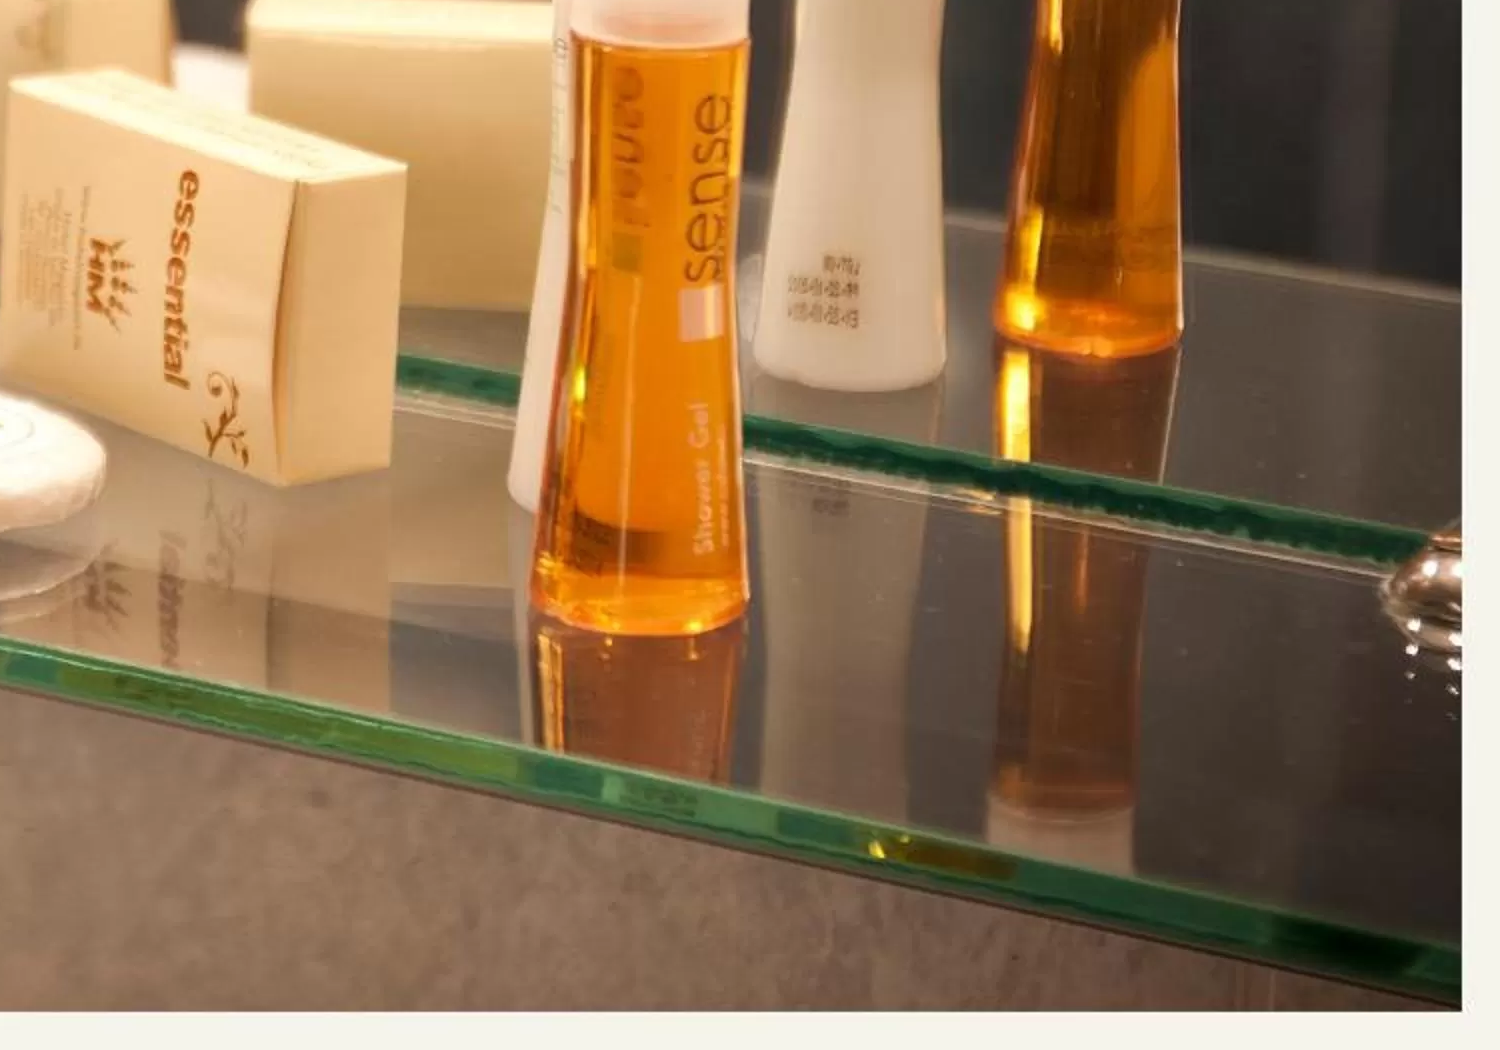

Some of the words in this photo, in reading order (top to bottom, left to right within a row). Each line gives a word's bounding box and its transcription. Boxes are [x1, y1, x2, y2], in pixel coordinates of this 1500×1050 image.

[684, 94, 732, 283] sense
[86, 237, 106, 313] HM
[162, 169, 199, 391] essential
[685, 401, 710, 449] Gel
[692, 458, 715, 556] Shower
